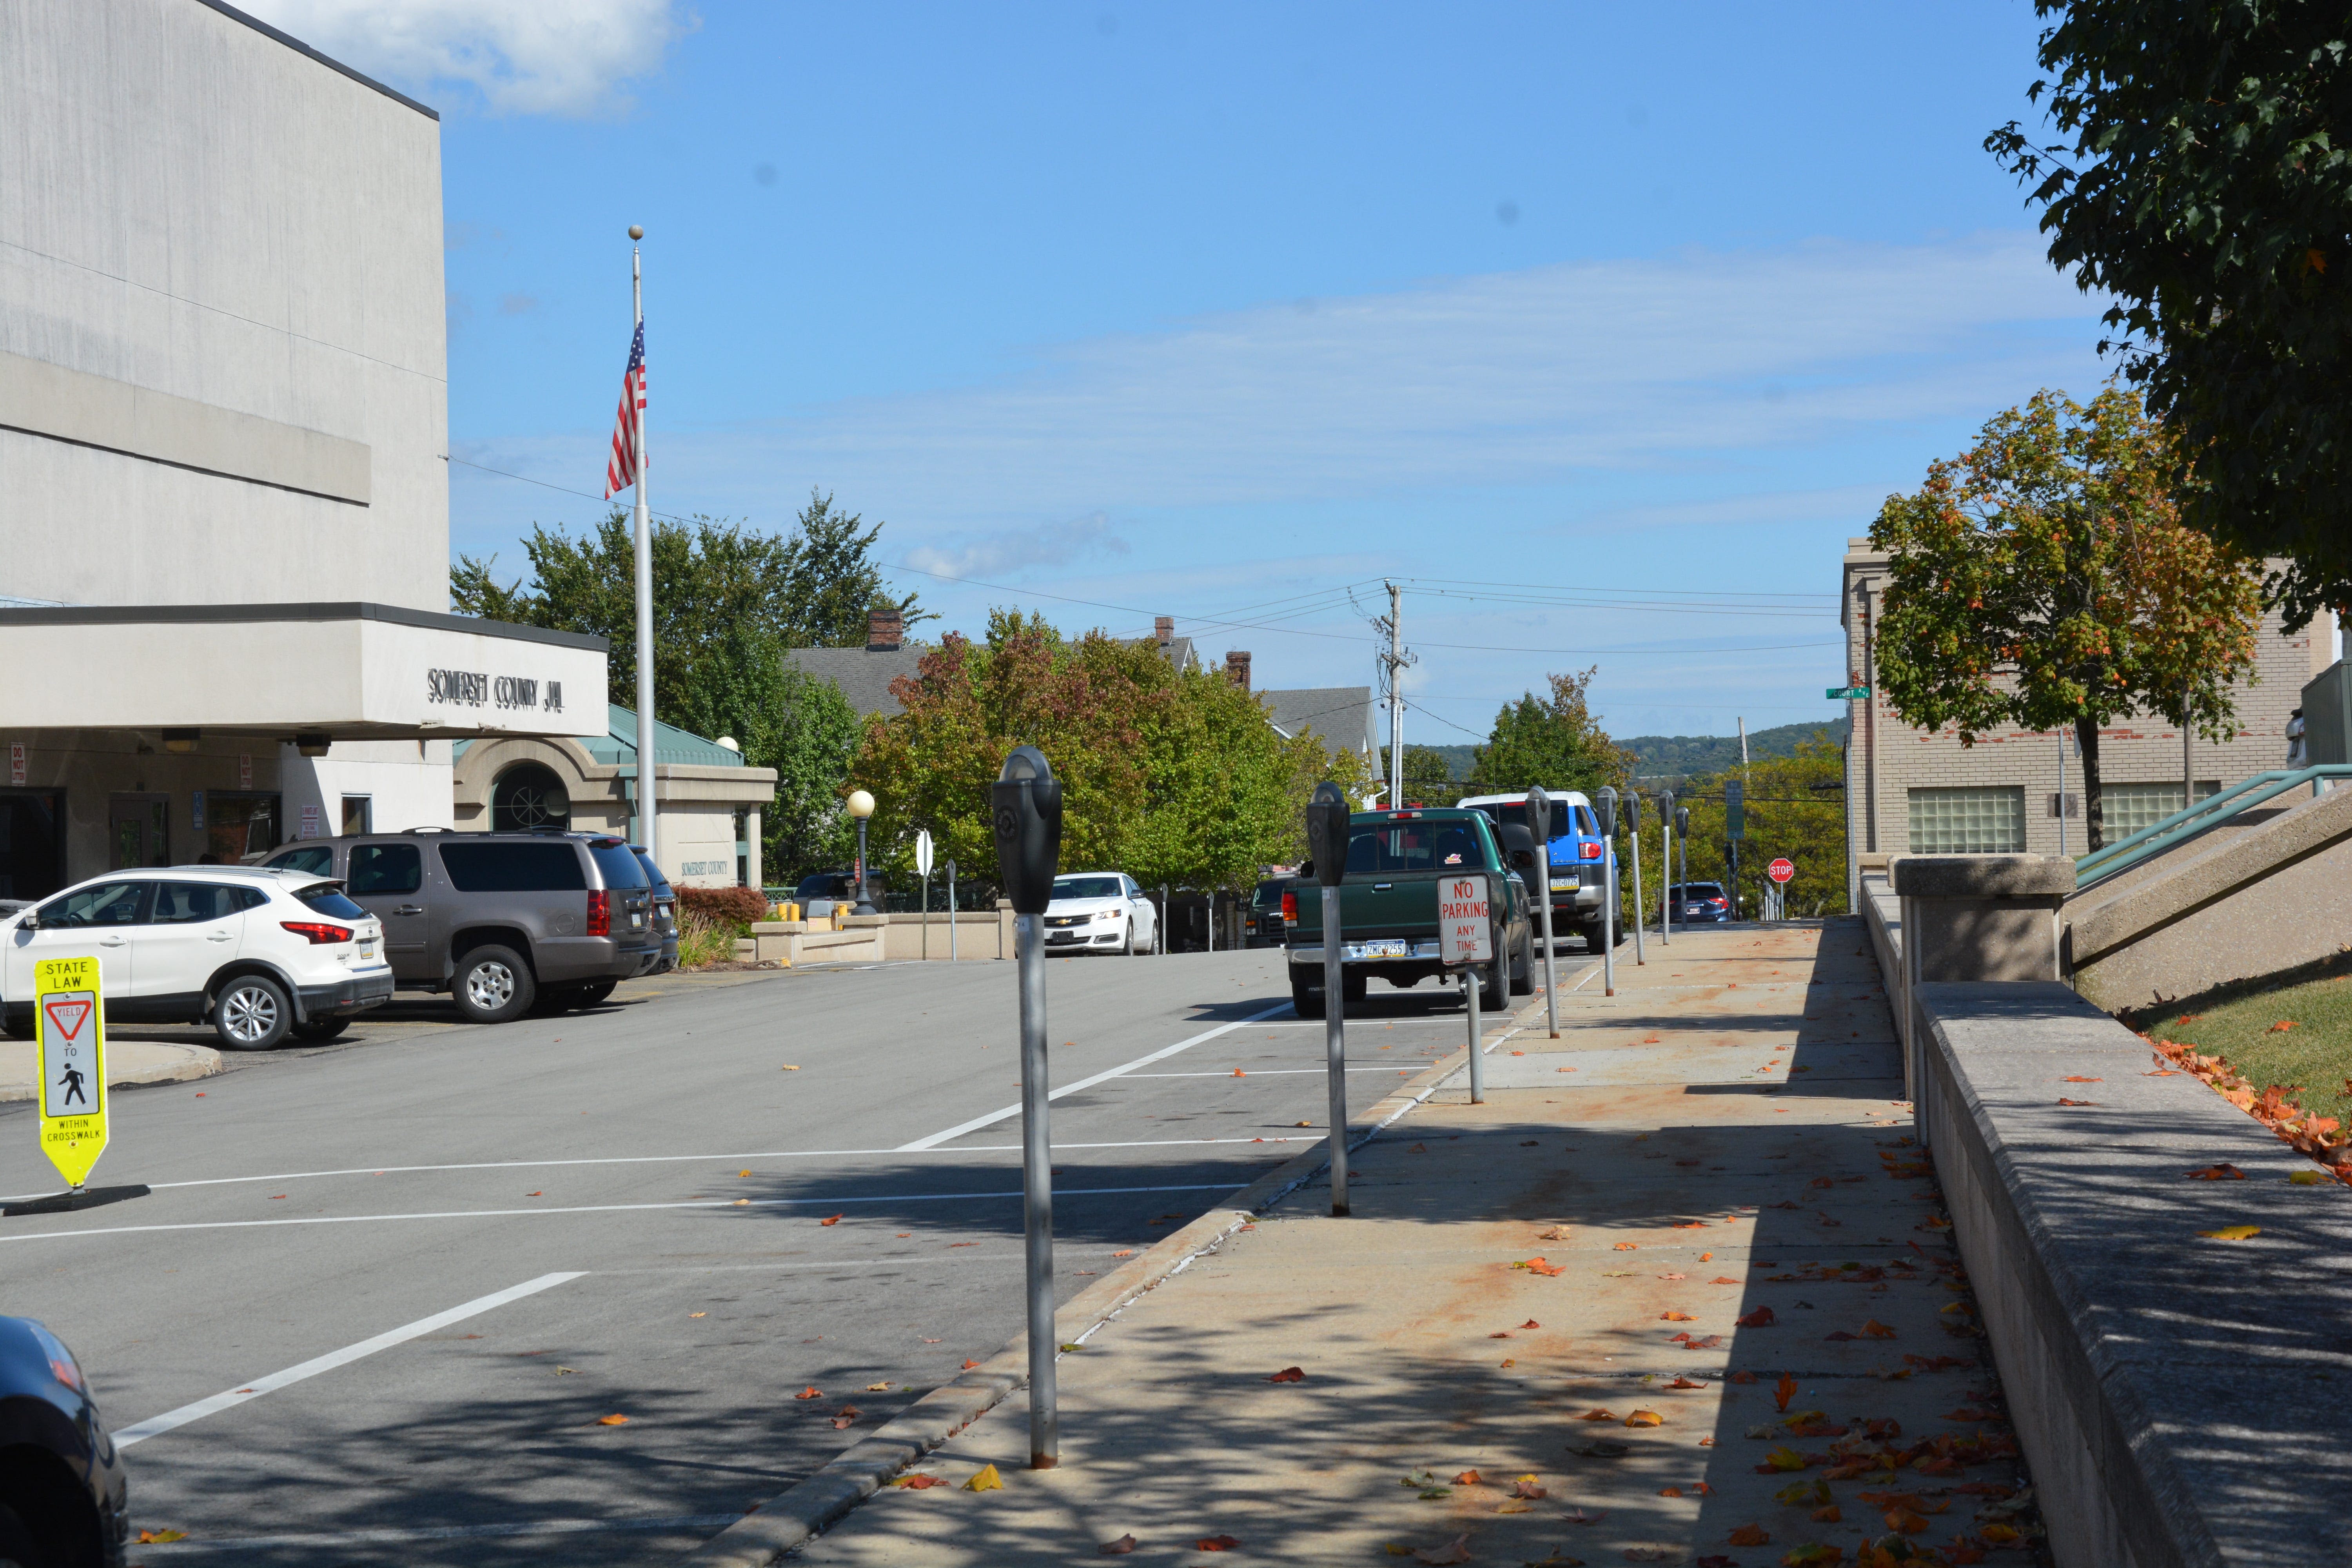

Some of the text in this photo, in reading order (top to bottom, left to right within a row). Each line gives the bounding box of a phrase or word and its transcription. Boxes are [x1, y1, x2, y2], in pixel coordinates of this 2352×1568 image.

[428, 668, 489, 702] SOMERSET
[494, 676, 538, 706] COUNTY
[1858, 688, 1869, 697] AVE
[13, 747, 22, 758] DO
[13, 760, 24, 769] NOT
[242, 755, 249, 765] DO
[12, 772, 24, 780] LITTER
[241, 767, 250, 776] NOT
[682, 861, 728, 876] SOMERSET COUNTY
[1771, 866, 1791, 875] STOP
[1454, 882, 1473, 899] NO
[1443, 901, 1488, 919] PARKING
[1457, 925, 1475, 936] ANY
[1456, 940, 1477, 952] TIME
[47, 962, 88, 975] STATE
[54, 976, 81, 989] LAW
[57, 1007, 80, 1017] YIELD
[64, 1048, 77, 1056] TO
[59, 1119, 89, 1129] WITHIN
[47, 1130, 100, 1142] CROSSWALK
